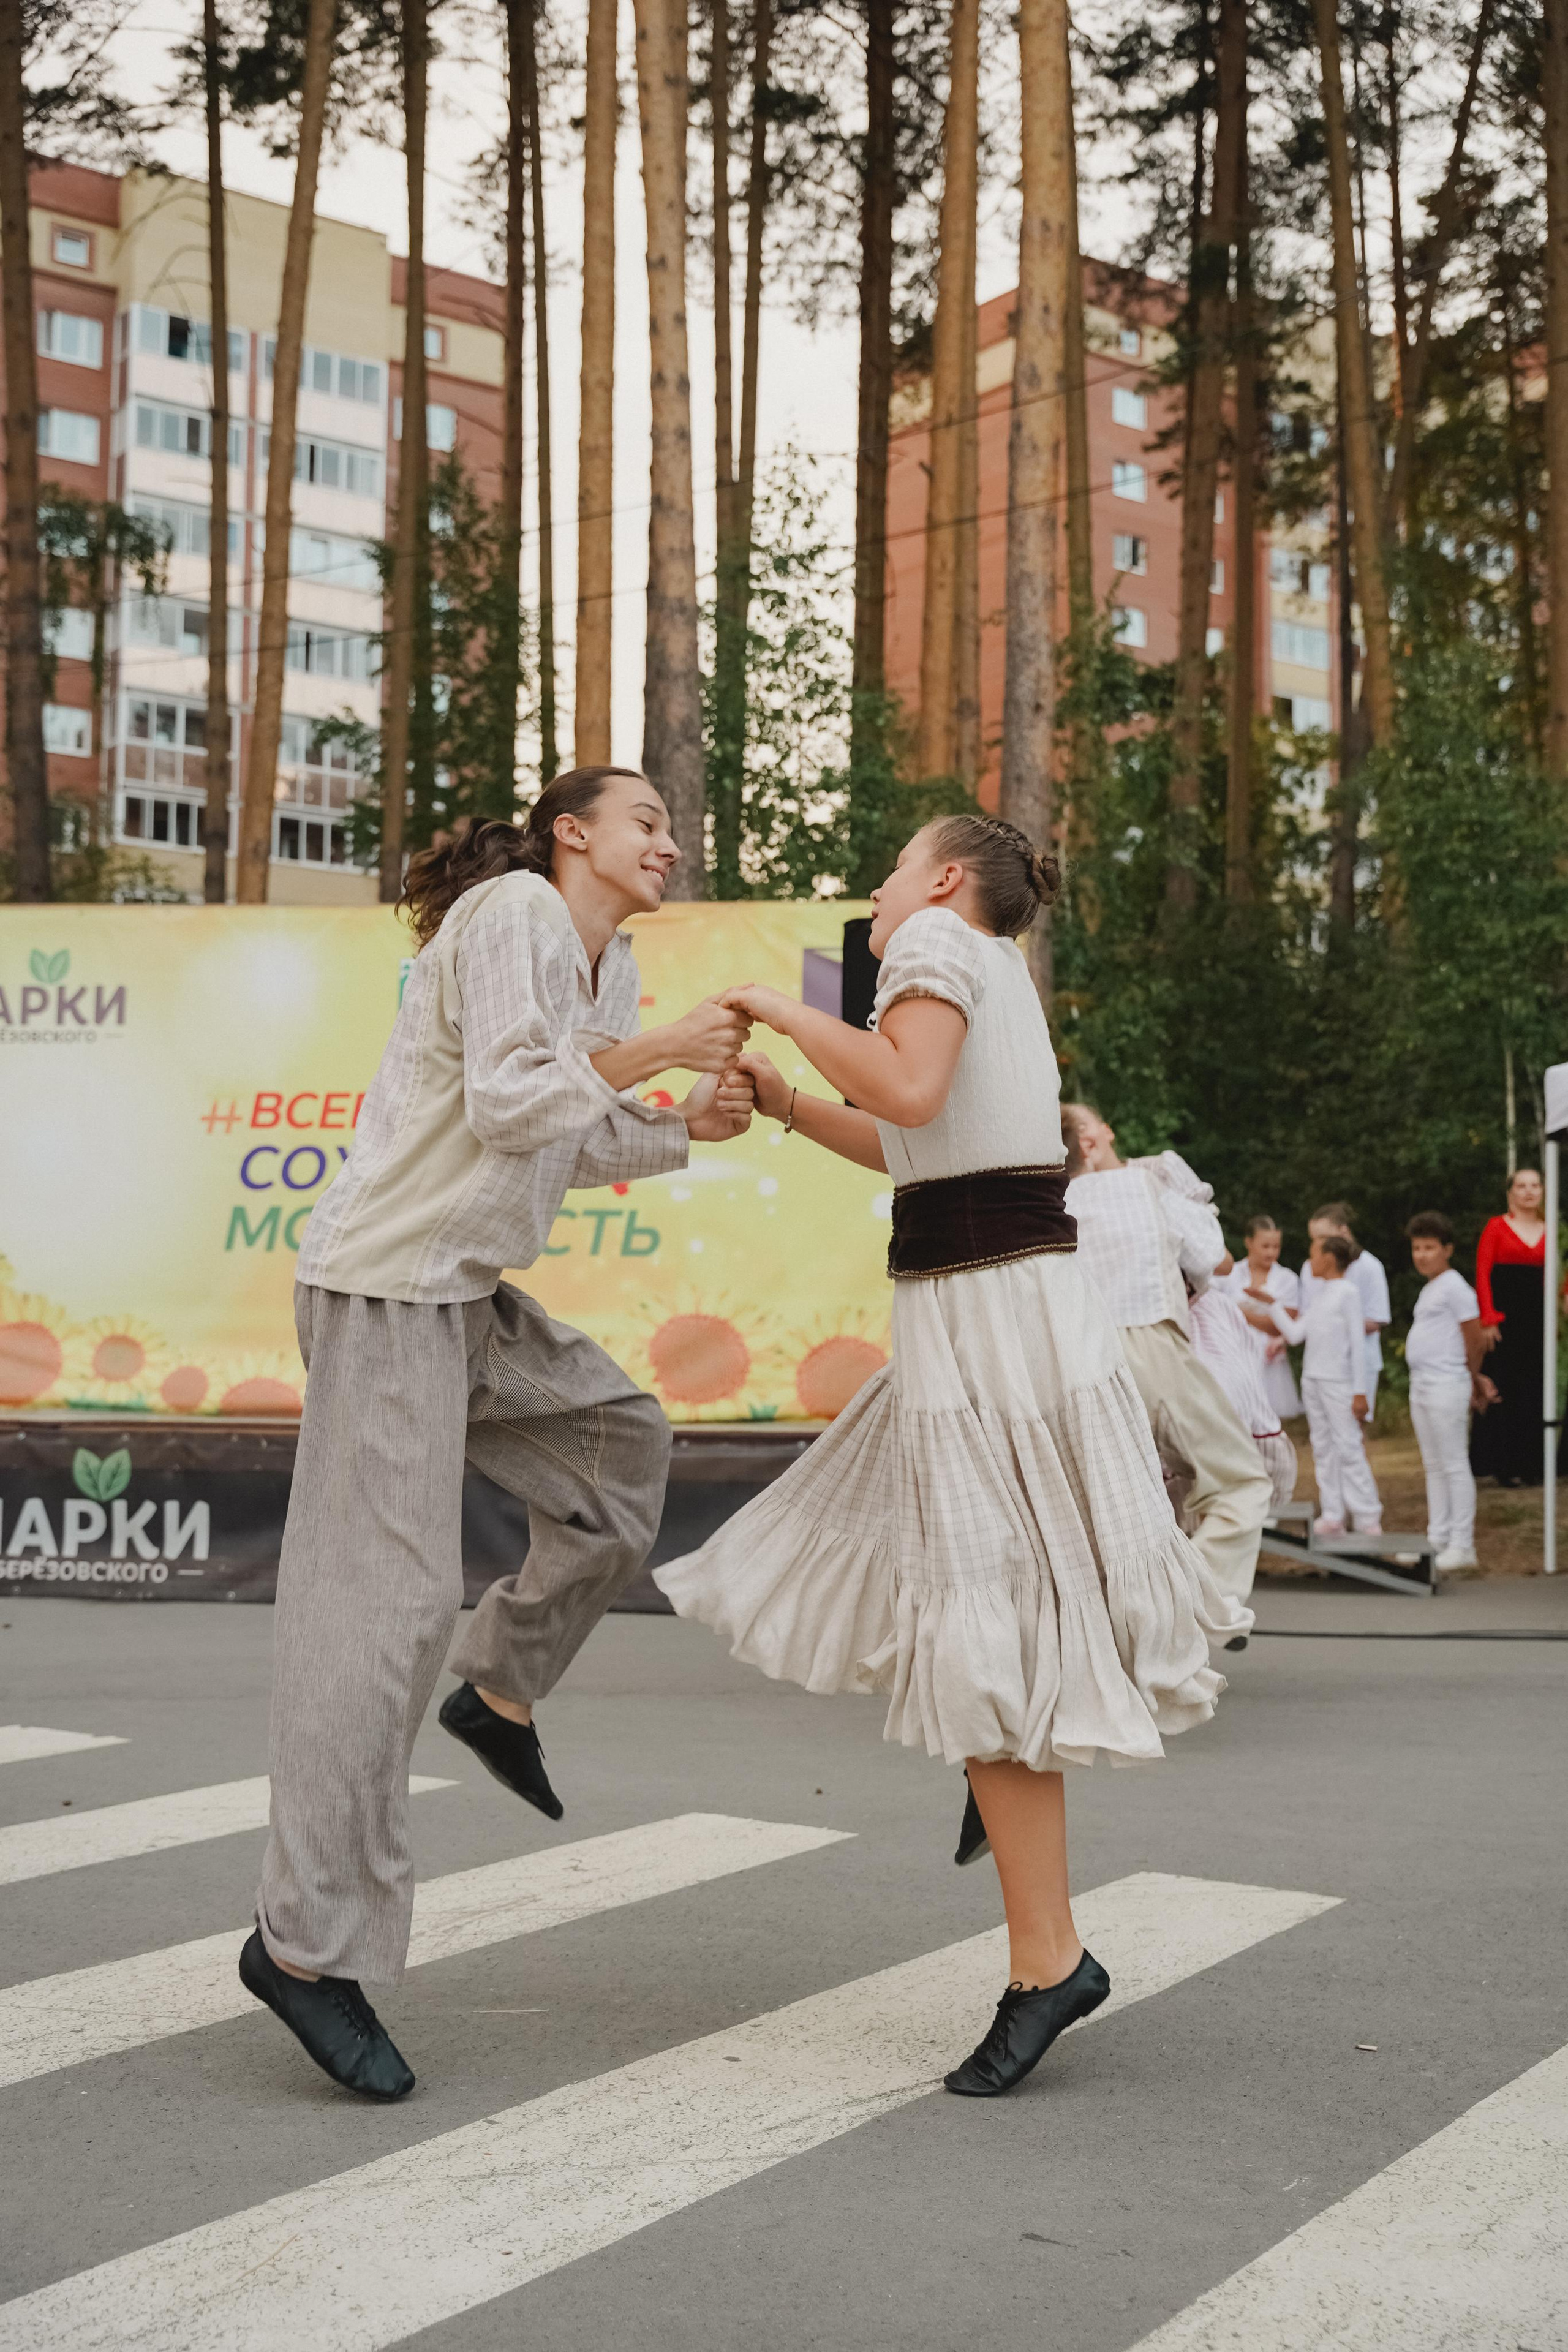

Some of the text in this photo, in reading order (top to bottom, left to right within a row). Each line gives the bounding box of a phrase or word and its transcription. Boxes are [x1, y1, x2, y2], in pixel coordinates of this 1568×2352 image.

[201, 1091, 365, 1133] #ВСЕ
[241, 1145, 348, 1190] СО
[0, 1498, 210, 1561] АРКИ
